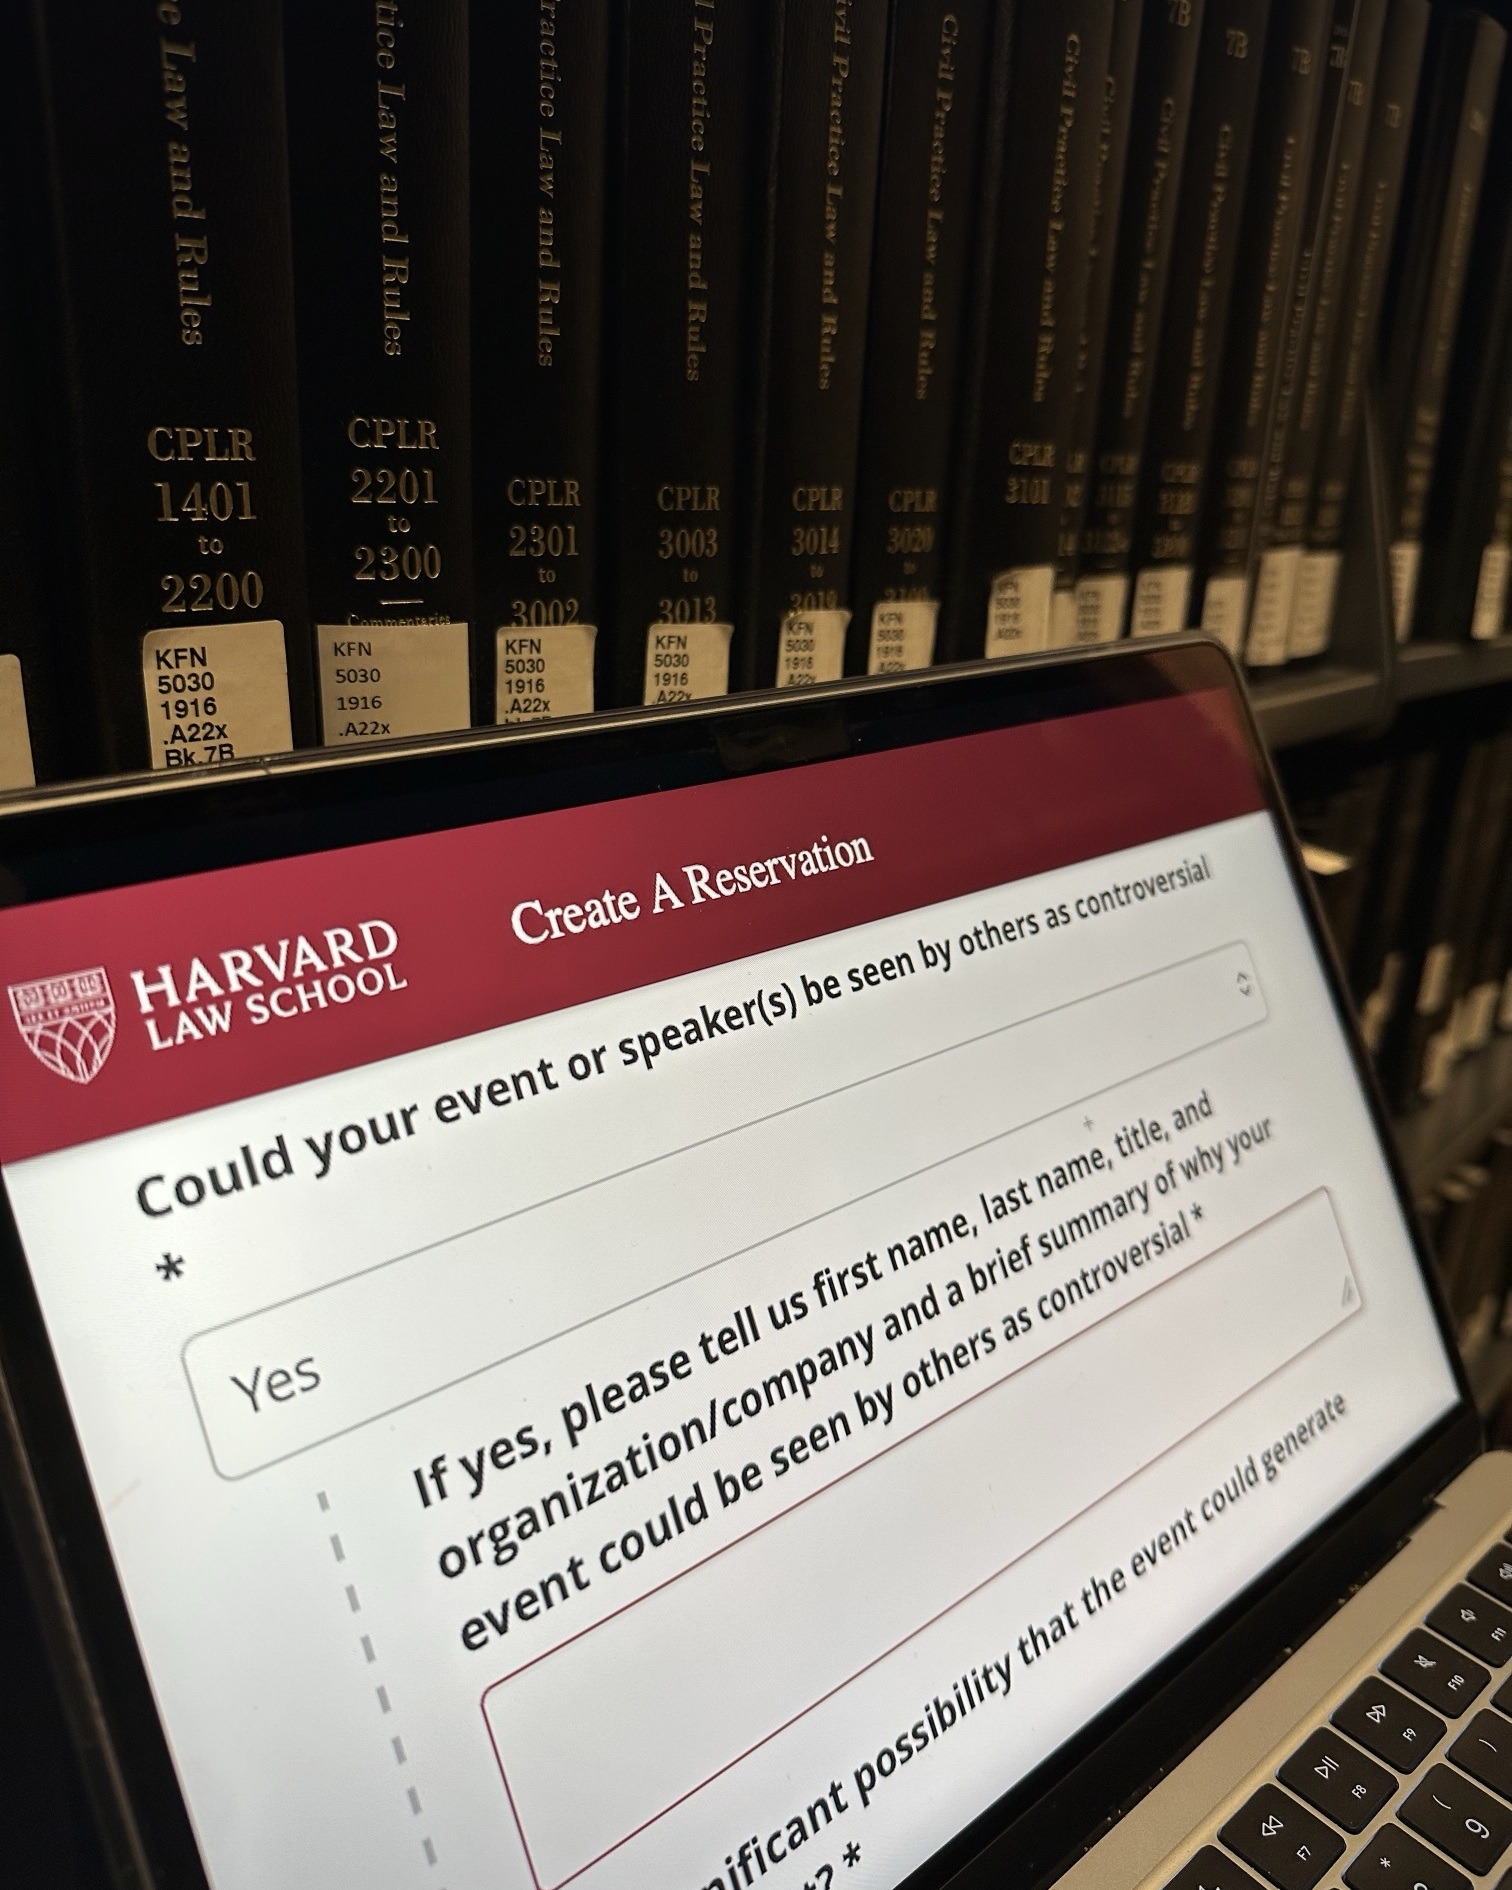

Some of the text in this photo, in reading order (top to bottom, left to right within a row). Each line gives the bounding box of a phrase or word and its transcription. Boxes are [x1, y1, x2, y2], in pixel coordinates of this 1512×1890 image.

[160, 41, 196, 130] Law
[691, 17, 714, 151] Practice
[378, 80, 405, 162] Law
[827, 50, 850, 176] Practice
[538, 126, 562, 199] Law
[168, 142, 206, 219] and
[689, 161, 711, 226] Law
[380, 172, 409, 243] and
[823, 183, 844, 246] Law
[916, 13, 959, 400] Civil Practice Law and Rules
[538, 206, 560, 267] and
[687, 233, 708, 289] and
[821, 251, 839, 304] and
[175, 233, 211, 345] Rules
[382, 254, 410, 356] Rules
[537, 279, 561, 367] Rules
[685, 301, 707, 382] Rules
[818, 311, 838, 389] Rules
[147, 426, 257, 463] CPLR
[347, 417, 440, 450] CPLR
[153, 480, 258, 522] 1401
[350, 467, 440, 505] 2201
[506, 478, 581, 508] CPLR
[657, 485, 721, 512] CPLR
[791, 485, 843, 513] CPLR
[387, 514, 412, 533] to
[198, 535, 225, 555] to
[508, 524, 580, 557] 2301
[658, 528, 719, 560] 3003
[790, 525, 841, 557] 3014
[354, 544, 442, 582] 2300
[538, 566, 556, 584] to
[682, 566, 699, 584] to
[160, 570, 264, 613] 2200
[511, 597, 580, 626] 3002
[155, 646, 207, 670] KFN
[333, 641, 372, 658] KFN
[505, 638, 542, 656] KFN
[654, 634, 687, 651] KFN
[785, 638, 815, 653] 5030
[335, 667, 381, 684] 5030
[504, 658, 545, 675] 5030
[653, 653, 690, 669] 5030
[158, 671, 215, 694] 5030
[504, 678, 545, 695] 1916
[653, 671, 689, 688] 1916
[161, 698, 217, 721] 1916
[336, 694, 383, 711] 1916
[504, 698, 551, 715] .A22x
[163, 722, 229, 746] .A22x
[338, 720, 391, 738] .A22x
[509, 832, 876, 947] Create A Reservation
[130, 919, 399, 1014] HARVARD
[144, 962, 409, 1052] LAW SCHOOL
[136, 854, 1213, 1219] Could your event or speaker(s) be seen by others as controversial
[412, 1088, 1214, 1509] If yes, please tell us first name, last name, title, and
[438, 1115, 1275, 1580] organization/company and a brief summary of why your
[230, 1356, 322, 1414] Yes
[460, 1554, 592, 1652] event
[599, 1482, 712, 1575] could
[713, 1460, 765, 1509] be
[769, 1409, 853, 1479] seen
[853, 1381, 895, 1426] by
[902, 1325, 997, 1399] others
[1000, 1304, 1033, 1343] as
[1037, 1215, 1192, 1321] controversial
[853, 1648, 1015, 1805] possibility
[1014, 1601, 1081, 1667] that
[1080, 1567, 1128, 1620] the
[1128, 1506, 1199, 1578] event
[1199, 1453, 1261, 1526] could
[1260, 1389, 1349, 1483] generate
[1447, 1674, 1466, 1692] F10
[1402, 1727, 1418, 1742] F9
[1351, 1784, 1368, 1800] F8
[1464, 1817, 1491, 1840] 9
[1296, 1845, 1315, 1862] F7
